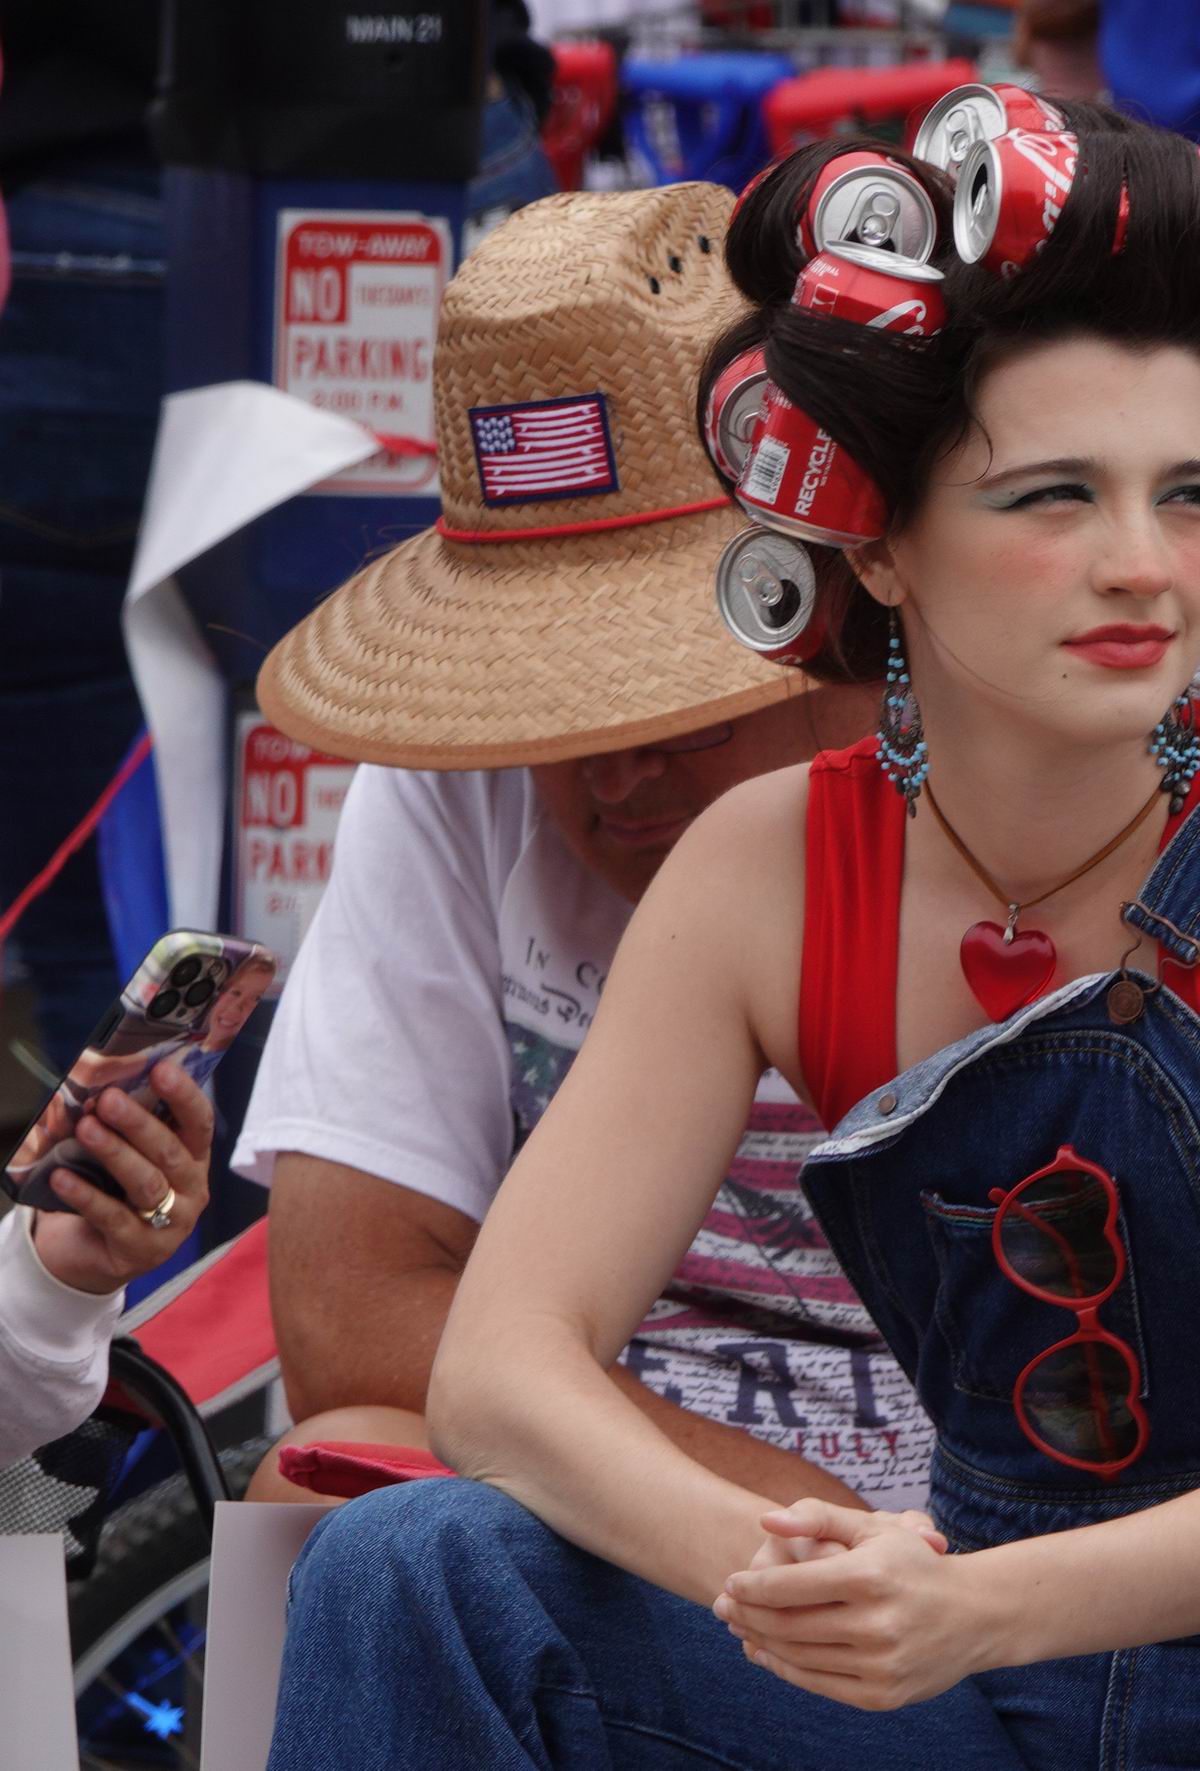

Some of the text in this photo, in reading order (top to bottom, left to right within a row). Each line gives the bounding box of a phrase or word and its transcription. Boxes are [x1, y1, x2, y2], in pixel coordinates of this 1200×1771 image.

[346, 15, 413, 42] MAIN
[297, 231, 431, 258] TOW-AWAY
[289, 268, 342, 321] NO
[292, 336, 428, 383] PARKING
[247, 770, 298, 827] NO
[251, 841, 333, 880] PARK
[795, 1428, 901, 1460] JULY
